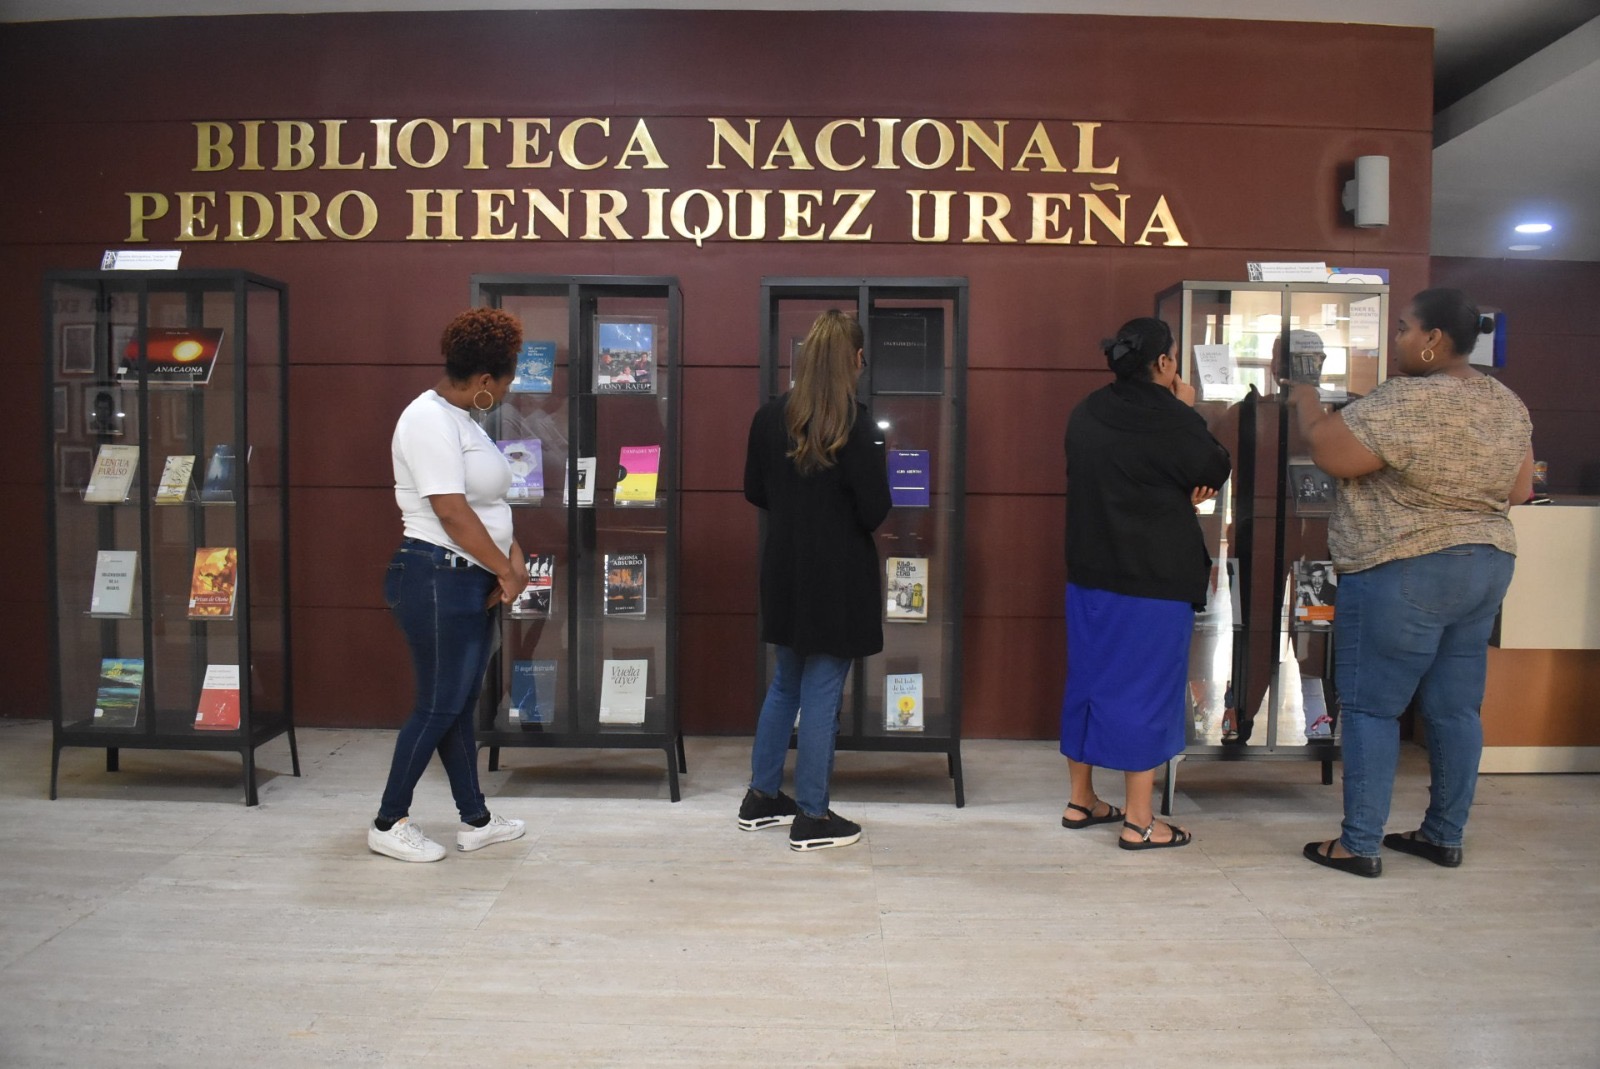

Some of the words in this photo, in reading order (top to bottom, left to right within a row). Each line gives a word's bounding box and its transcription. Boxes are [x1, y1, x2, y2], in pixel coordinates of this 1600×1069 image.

[191, 118, 669, 171] BIBLIOTECA
[707, 118, 1119, 174] NACIONAL
[124, 190, 378, 242] PEDRO
[406, 189, 876, 247] HENRIQUEZ
[906, 182, 1188, 246] UREÑA
[612, 665, 640, 677] Vuelta
[615, 676, 639, 688] ayer
